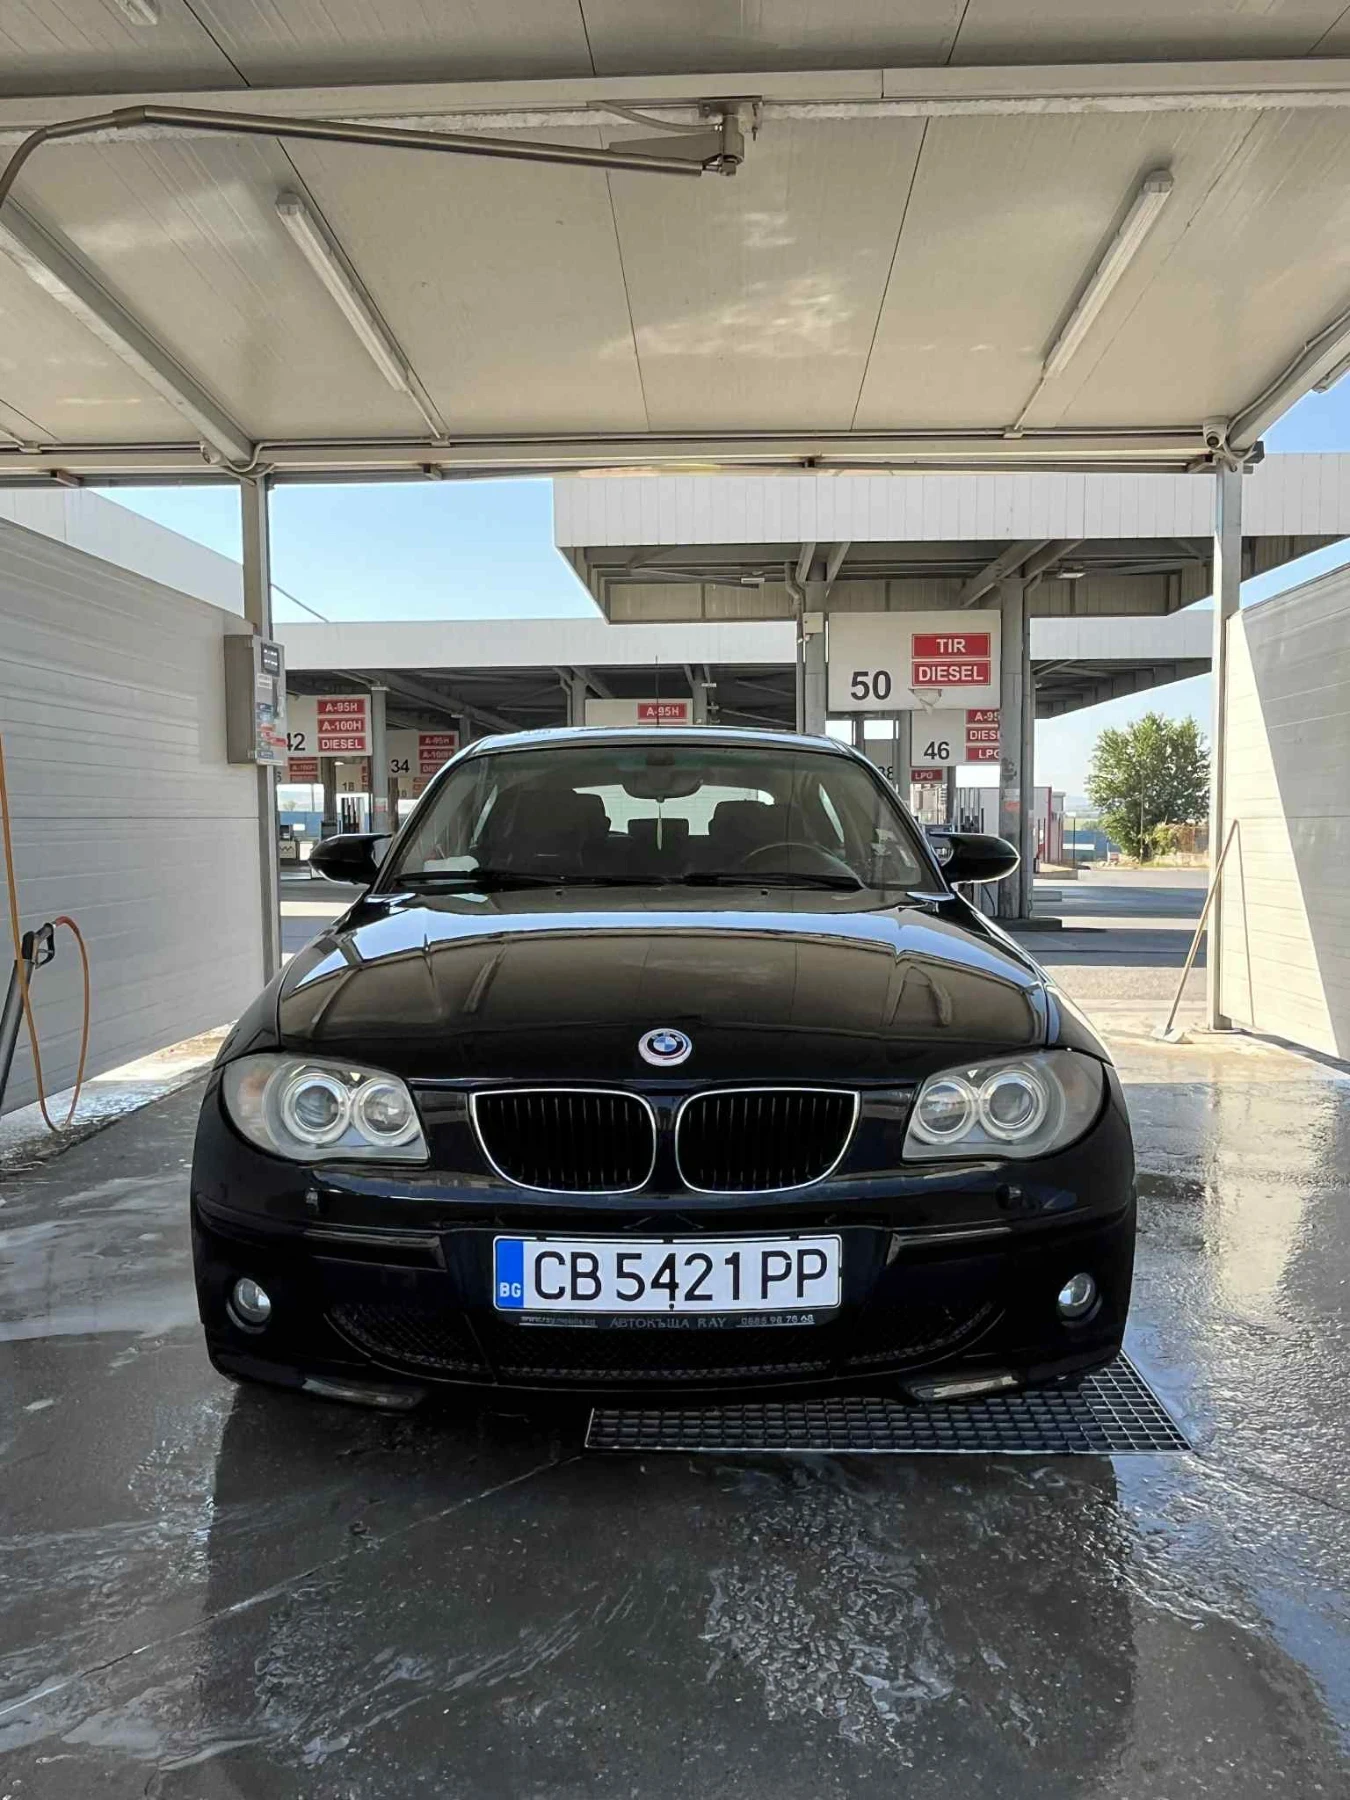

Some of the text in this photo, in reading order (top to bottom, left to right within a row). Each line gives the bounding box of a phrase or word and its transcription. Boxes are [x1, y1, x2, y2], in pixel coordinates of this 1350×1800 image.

[936, 638, 966, 654] TIR
[918, 666, 984, 682] DIESEL
[850, 670, 892, 701] 50
[325, 702, 358, 712] A-95H
[646, 706, 679, 717] A-95H
[974, 711, 1000, 722] A-95
[322, 720, 362, 731] A-100H
[969, 730, 1000, 740] DIES
[321, 738, 362, 749] DIESEL
[923, 741, 950, 760] 46
[390, 759, 410, 773] 34
[534, 1248, 828, 1302] CB 5421 PP
[499, 1282, 522, 1298] BG
[697, 1317, 727, 1328] RAY
